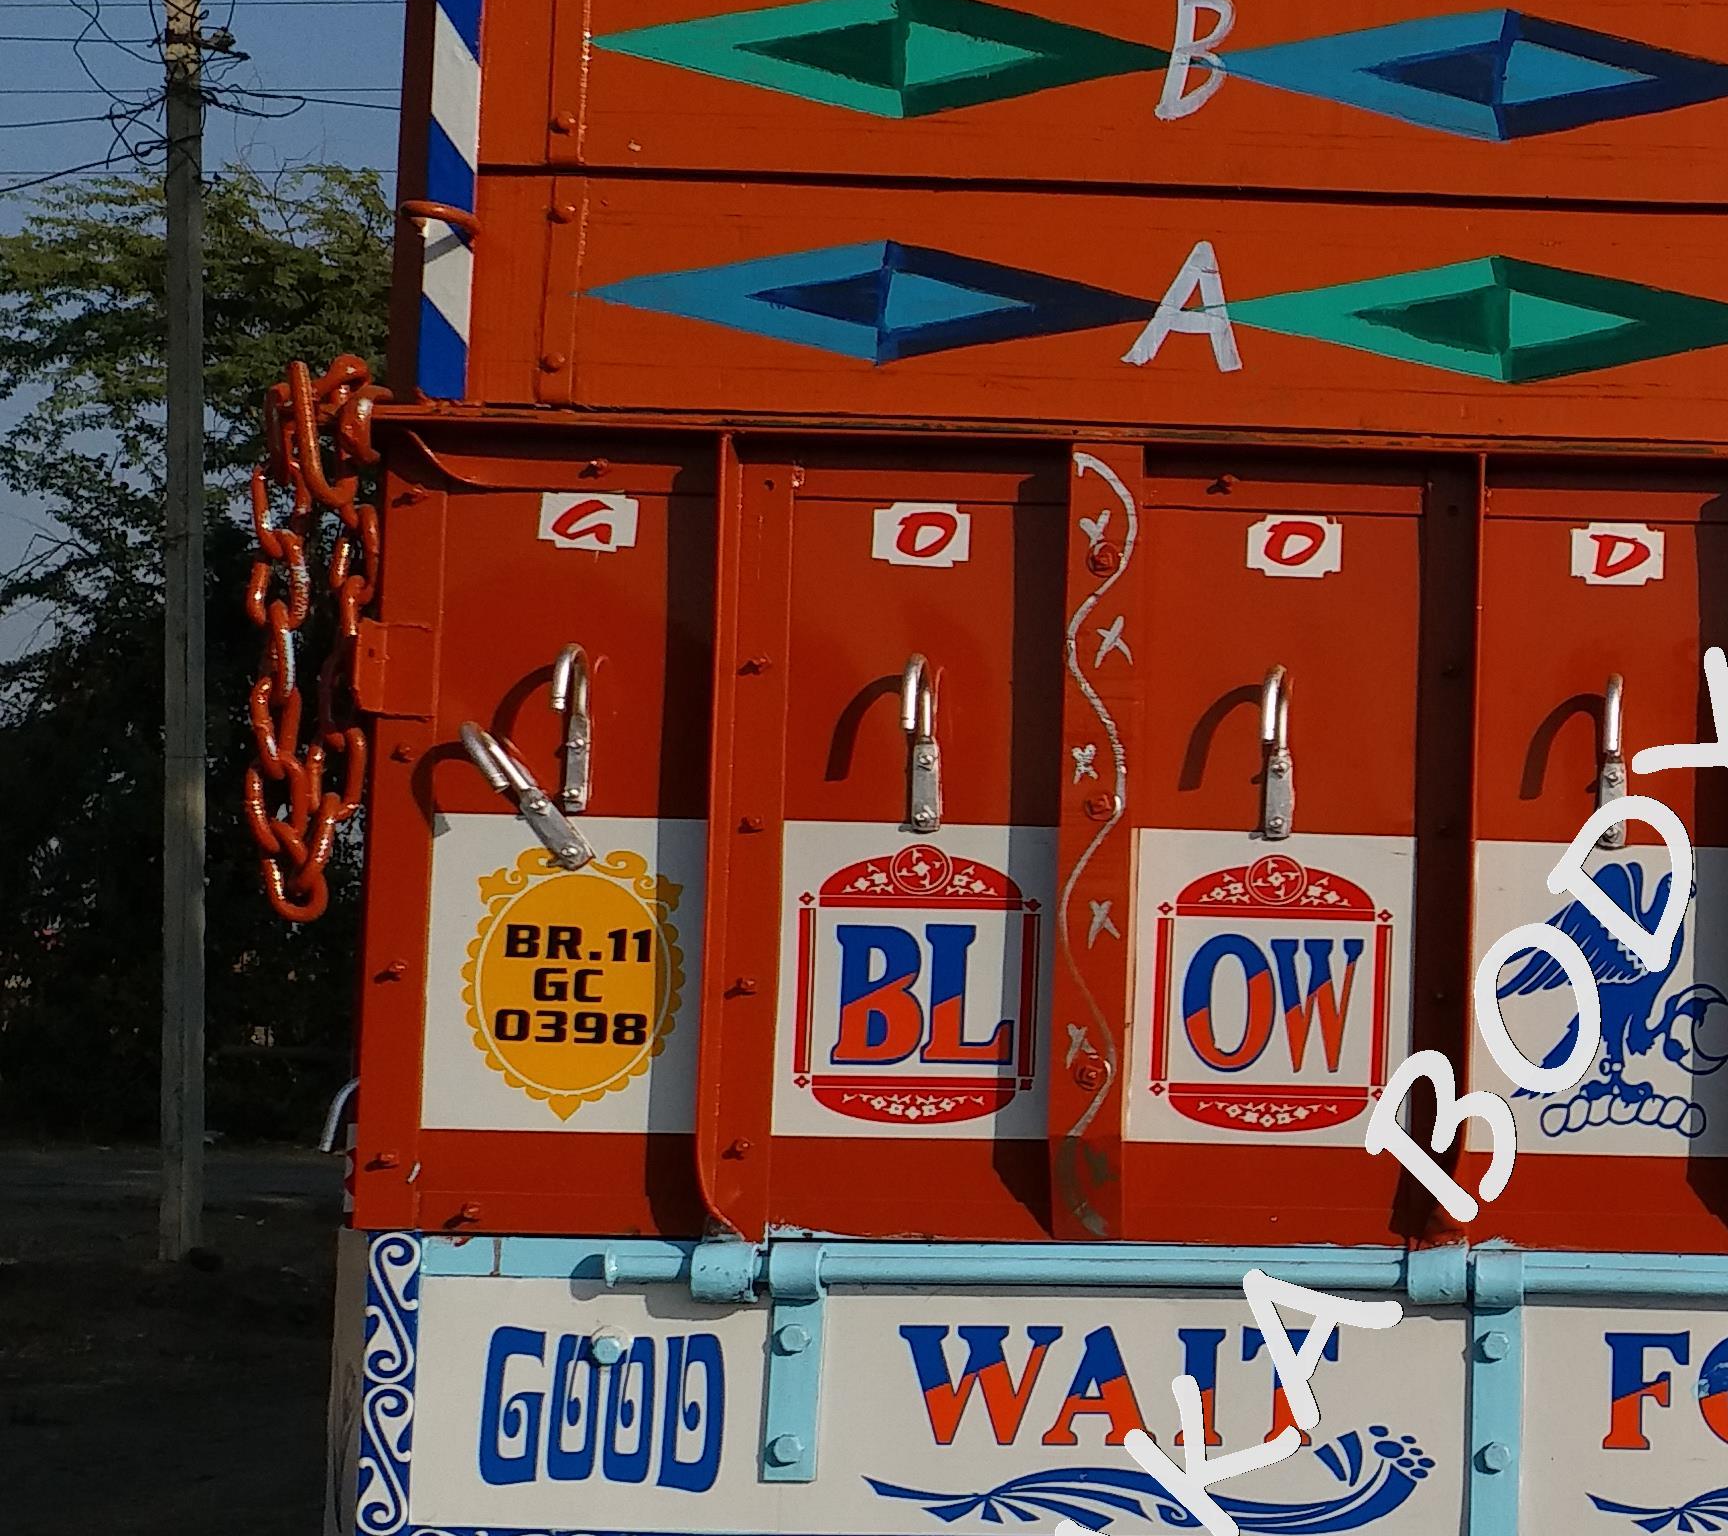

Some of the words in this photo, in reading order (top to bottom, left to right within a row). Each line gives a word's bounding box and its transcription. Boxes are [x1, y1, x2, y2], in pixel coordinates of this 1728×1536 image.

[1121, 241, 1243, 372] A
[1590, 532, 1650, 577] D
[504, 924, 653, 962] BR.11
[532, 969, 604, 1004] GC
[830, 924, 1014, 1066] BL
[1182, 932, 1364, 1074] OW
[493, 1010, 648, 1045] 0398
[480, 1326, 726, 1493] GOOD
